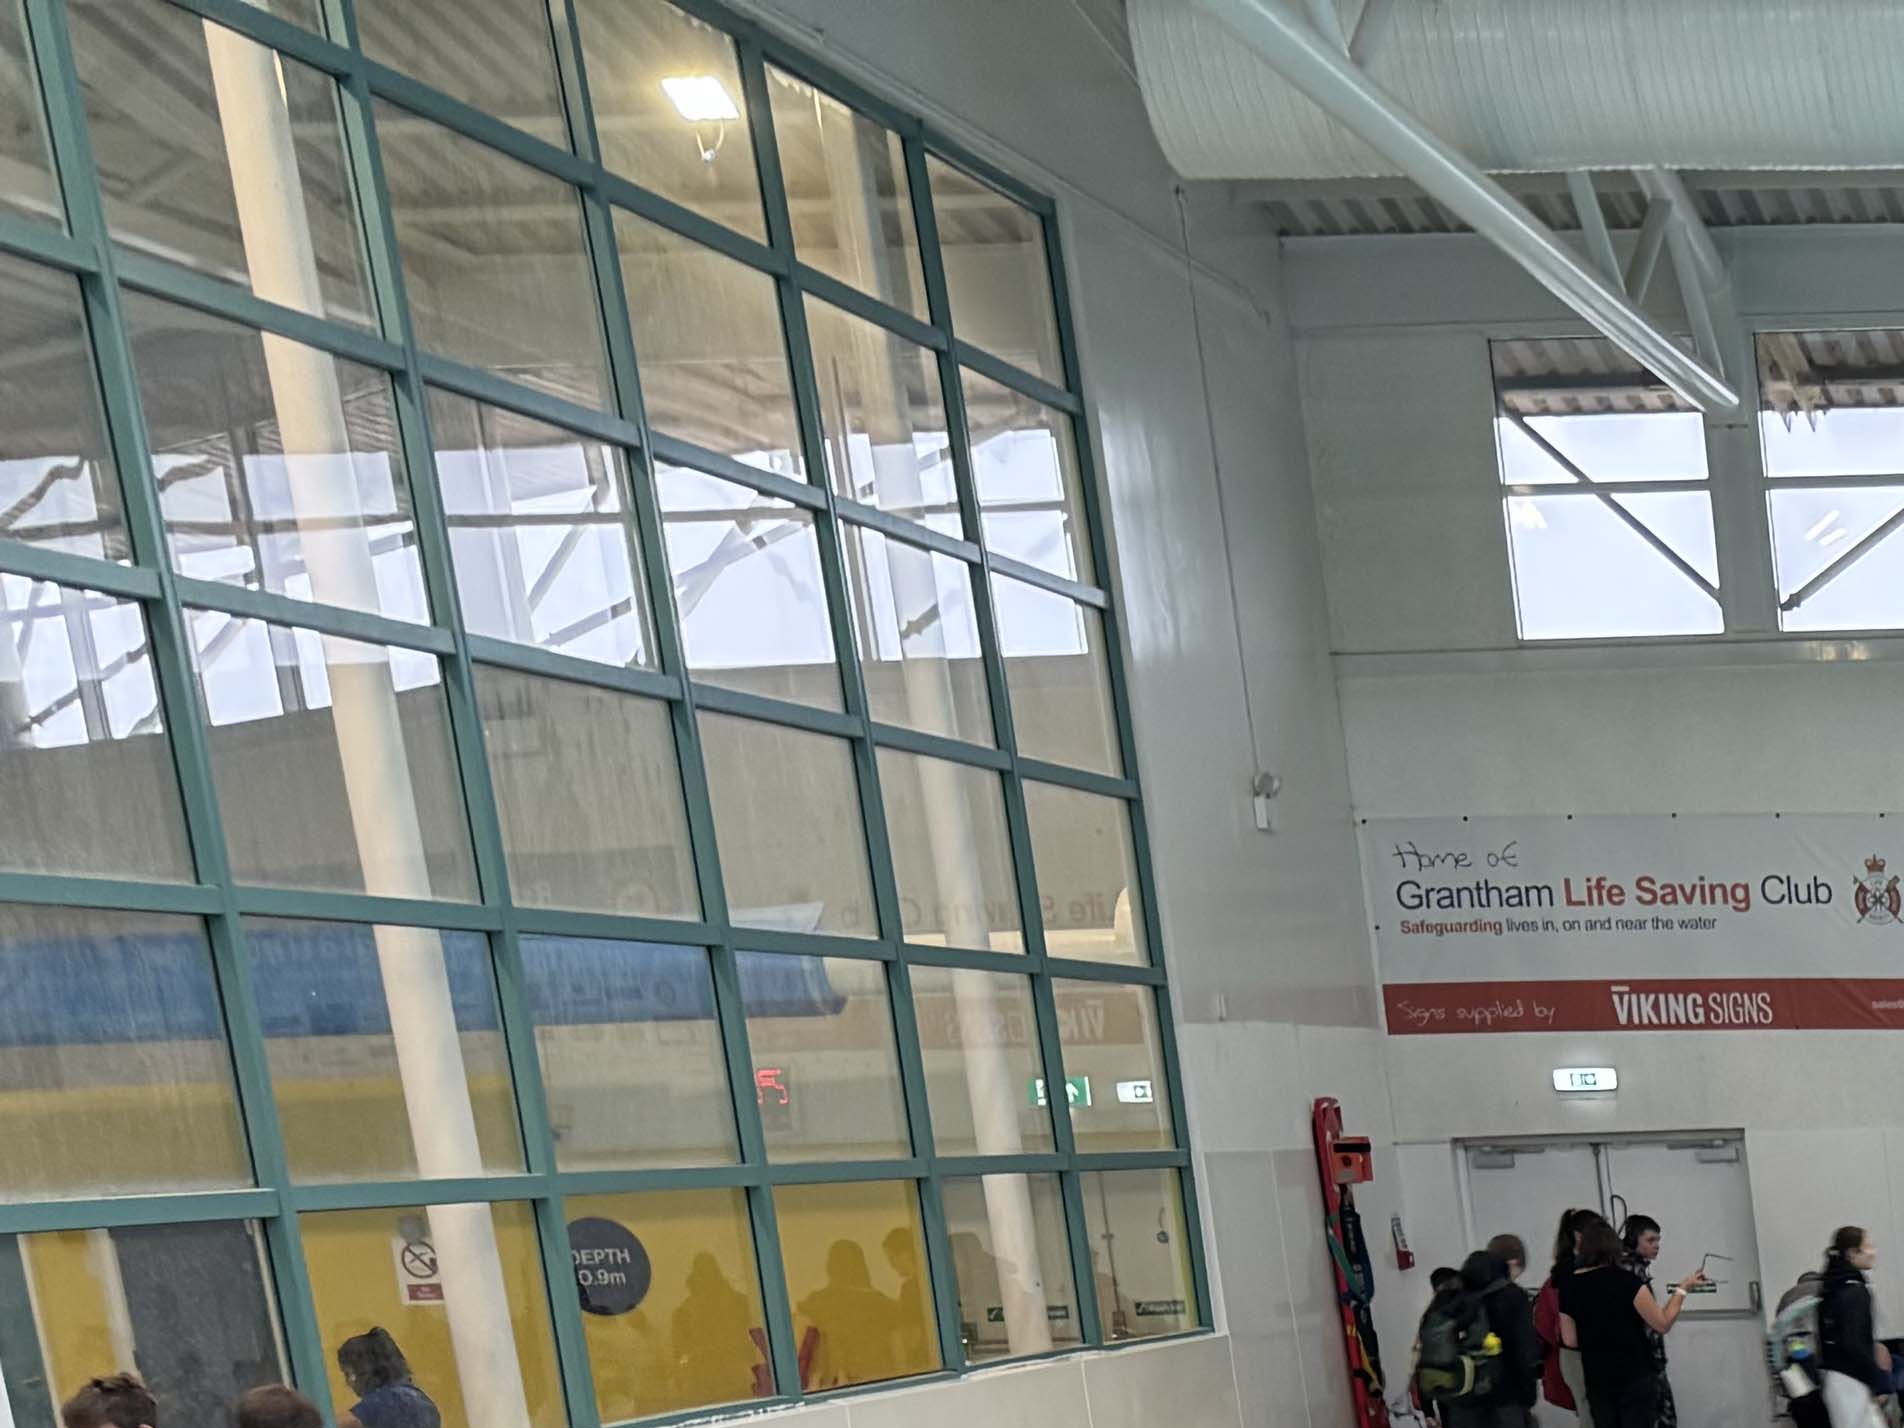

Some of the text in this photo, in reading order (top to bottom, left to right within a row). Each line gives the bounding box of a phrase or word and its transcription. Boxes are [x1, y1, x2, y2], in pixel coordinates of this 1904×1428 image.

[1392, 840, 1519, 872] Home of
[1396, 874, 1833, 912] Grantham Life Saving Club
[1400, 919, 1504, 937] Safeguarding
[1506, 918, 1539, 933] lives
[1562, 920, 1581, 932] on
[1584, 916, 1612, 932] and
[1615, 917, 1648, 931] near
[1651, 916, 1674, 930] the
[1677, 916, 1717, 930] water
[1611, 989, 1773, 1025] VIKING SIGNS
